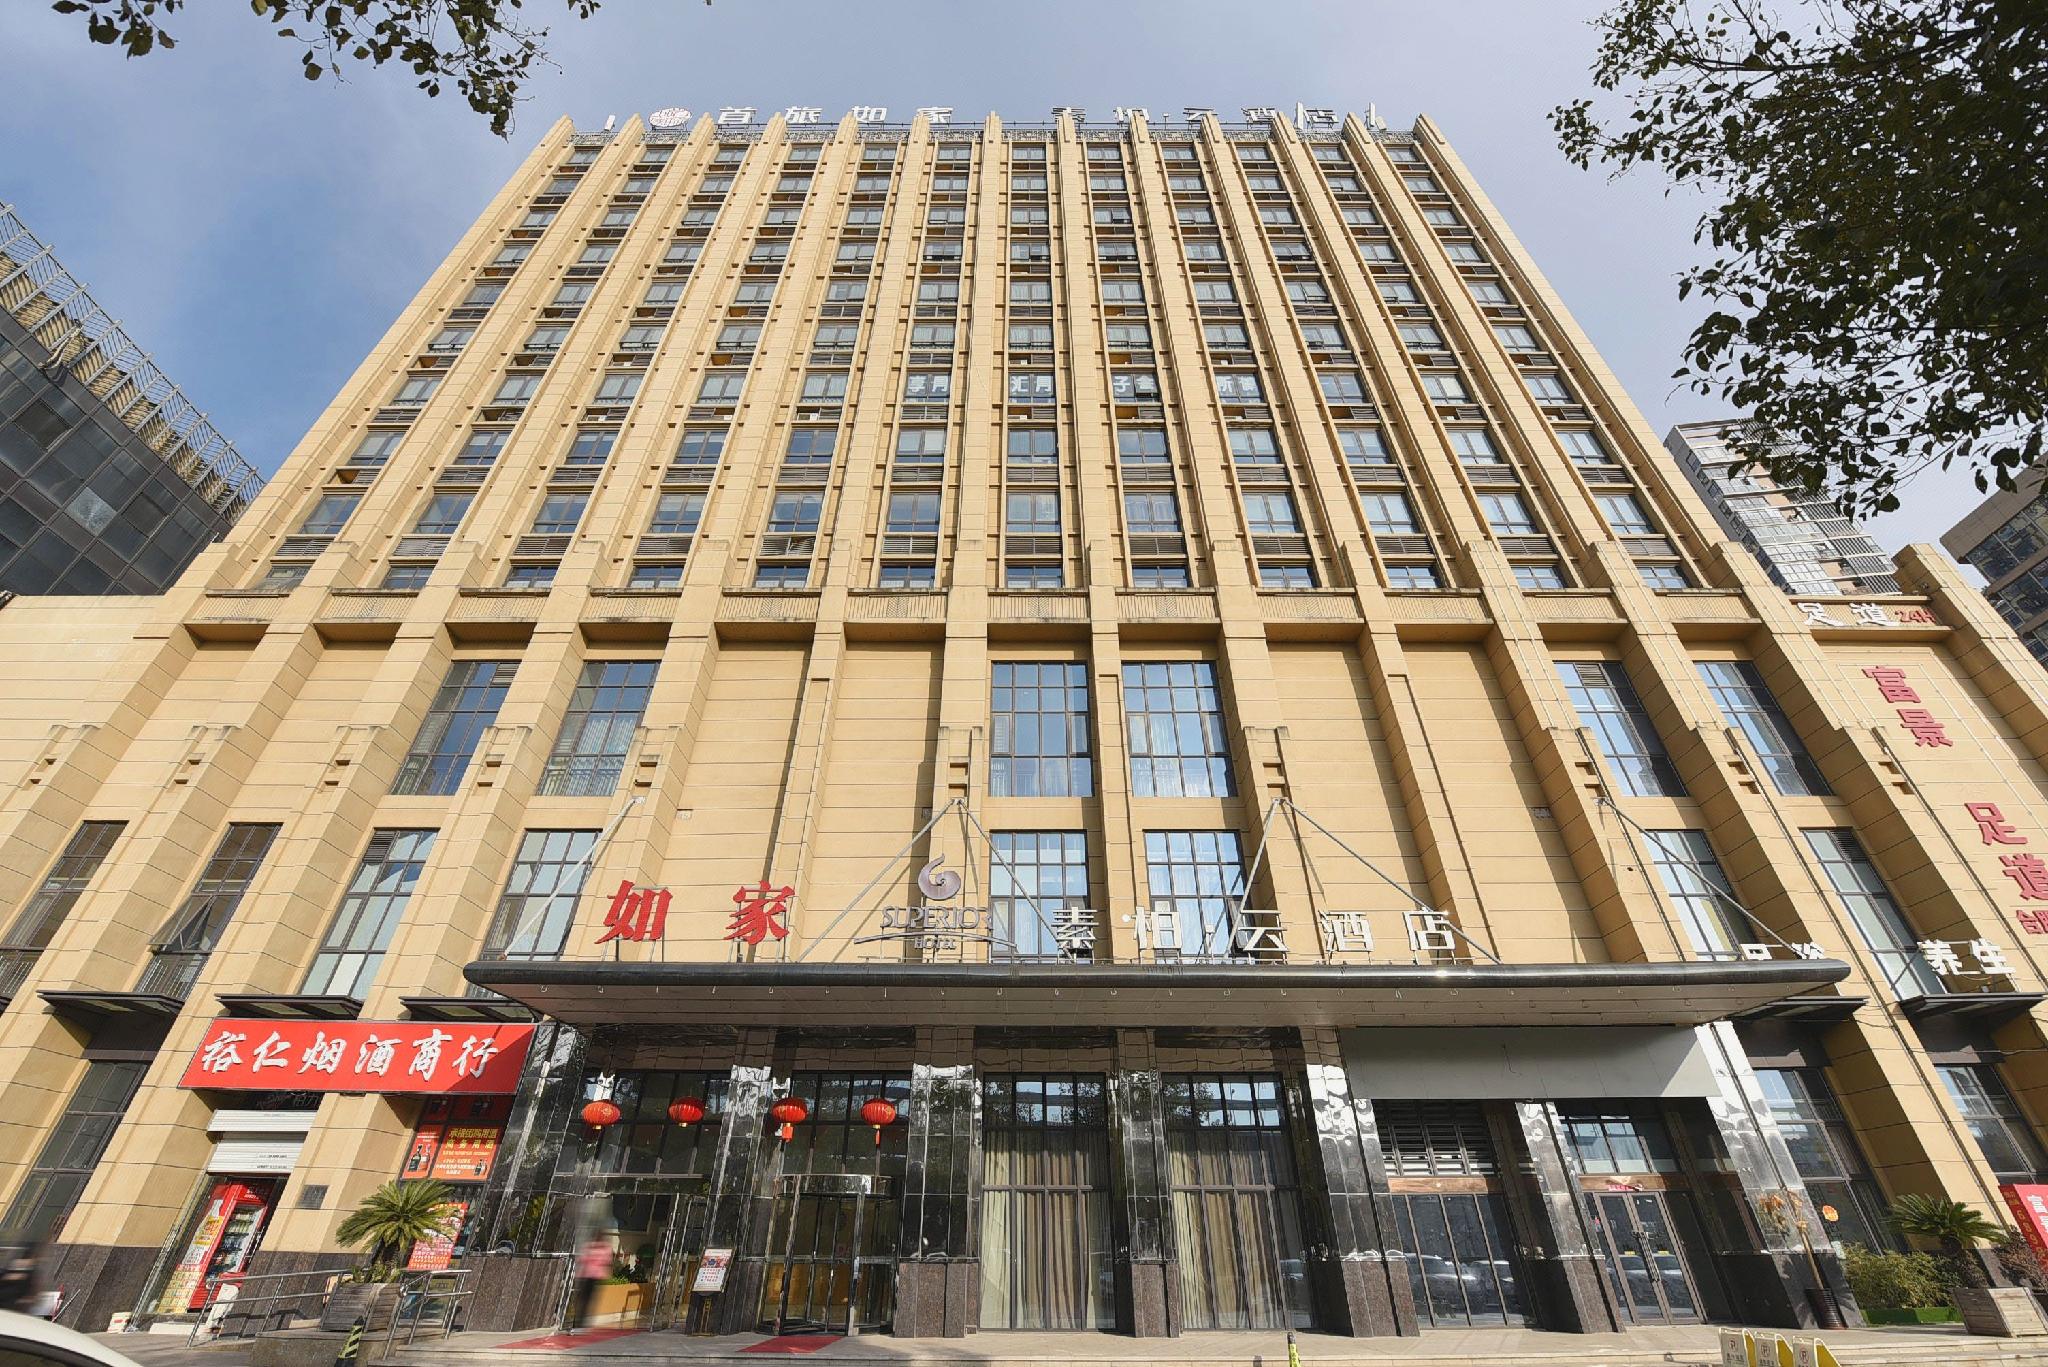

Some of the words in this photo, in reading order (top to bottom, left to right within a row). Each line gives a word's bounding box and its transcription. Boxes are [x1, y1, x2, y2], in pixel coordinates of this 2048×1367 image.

[717, 106, 953, 124] 首旅如家
[1797, 602, 1901, 627] 足道
[1862, 665, 1954, 747] 富景
[594, 880, 796, 944] 如家
[880, 905, 993, 929] SUPERIOR
[914, 937, 956, 949] HOTEL
[1917, 938, 2016, 975] 养生
